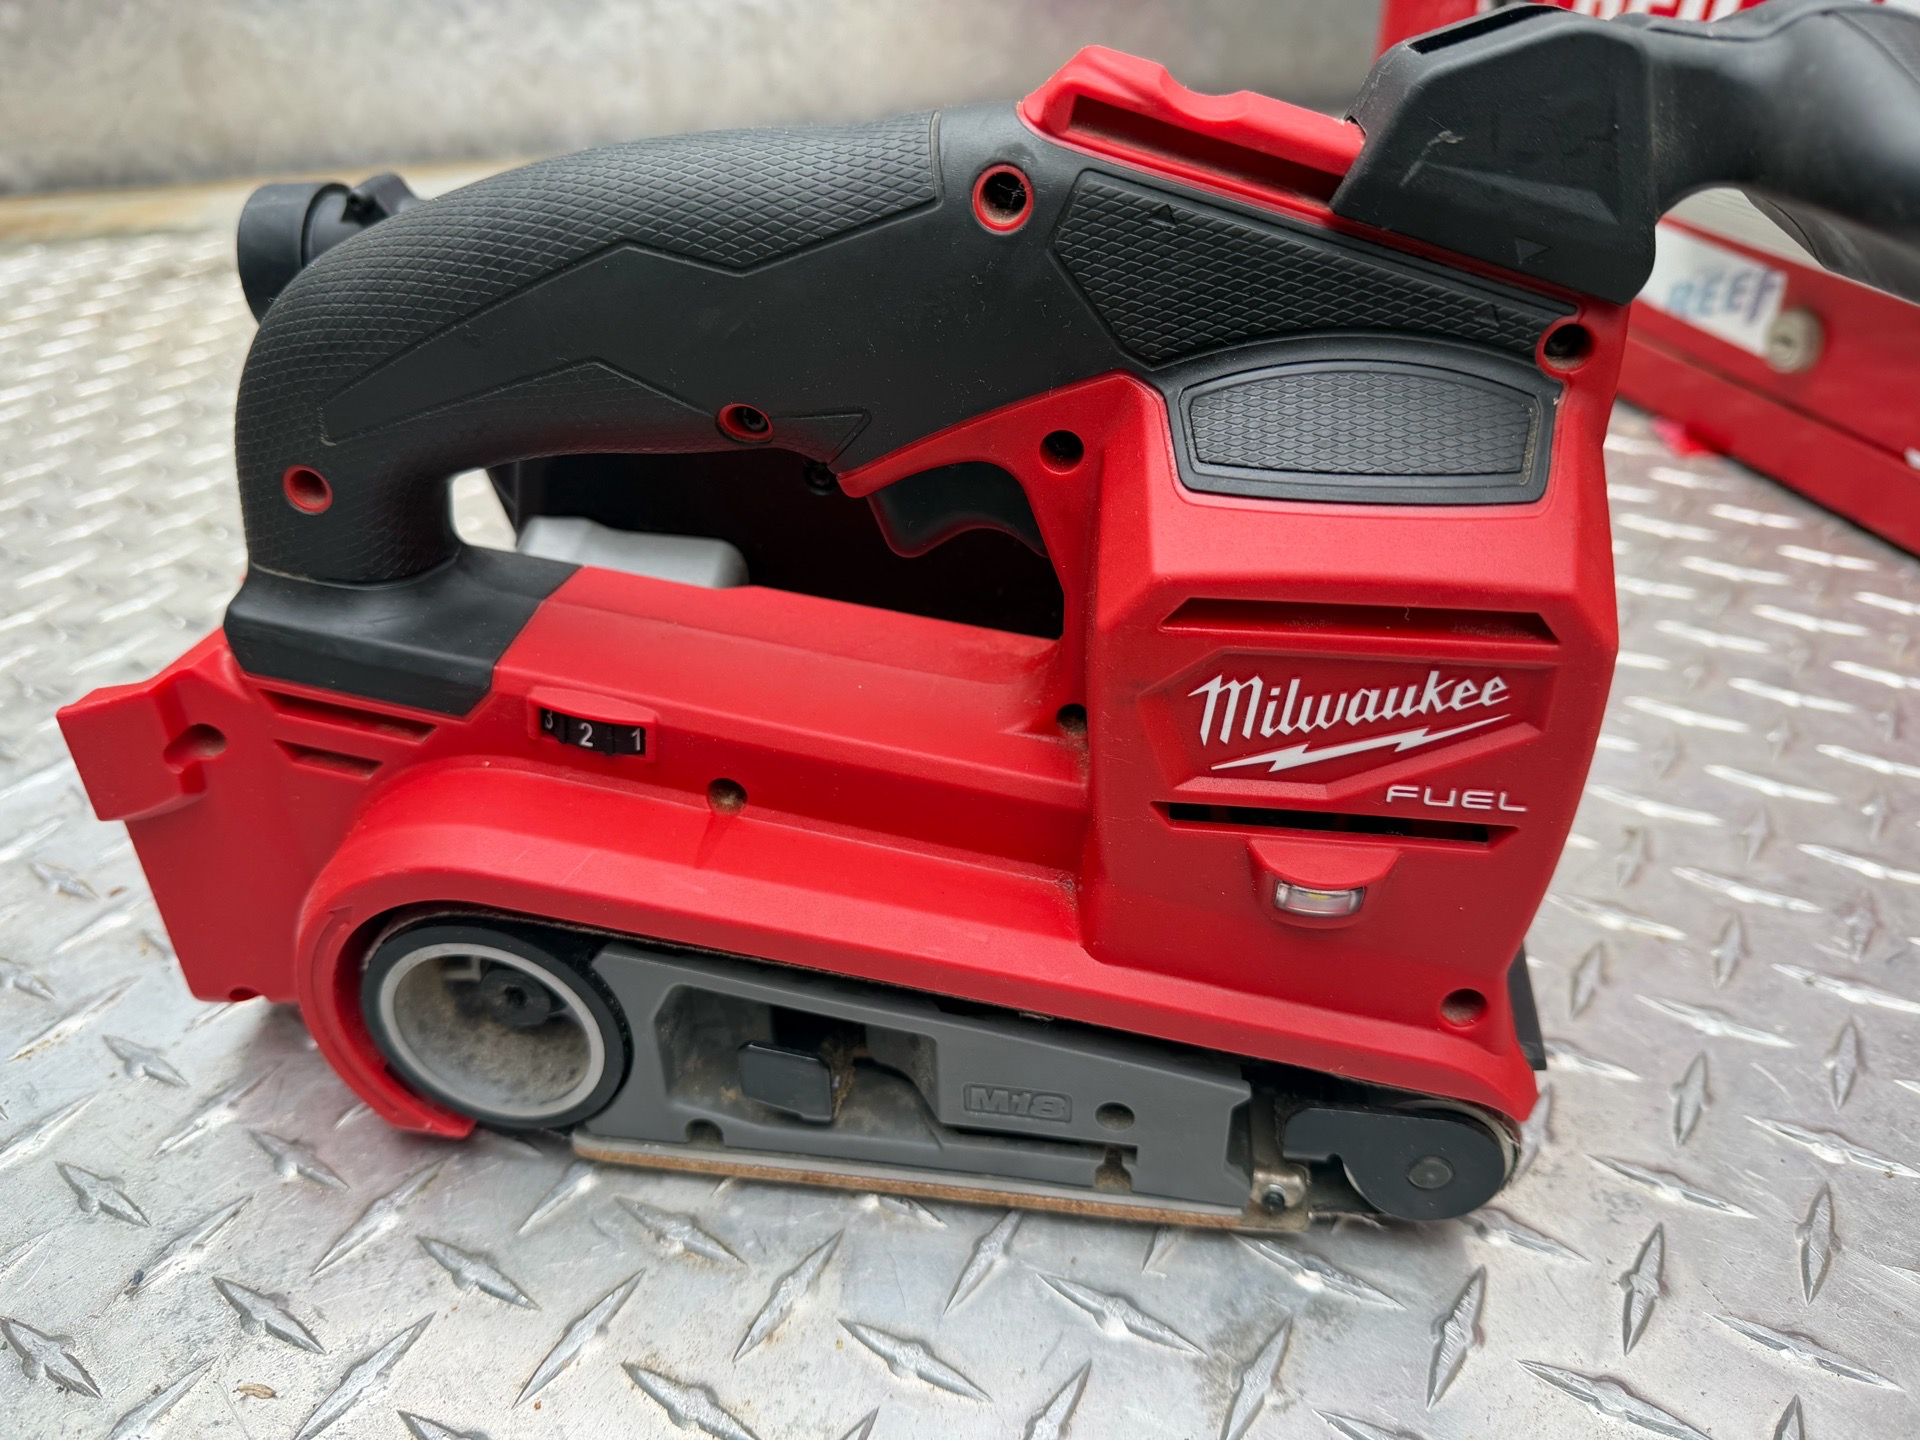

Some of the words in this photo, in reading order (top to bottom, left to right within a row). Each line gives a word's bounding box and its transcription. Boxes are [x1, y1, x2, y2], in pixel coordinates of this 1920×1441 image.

[1188, 670, 1510, 746] Milwaukee
[579, 722, 594, 748] 2
[631, 727, 642, 751] 1
[1385, 785, 1528, 812] FUEL
[969, 1086, 1066, 1119] M18
